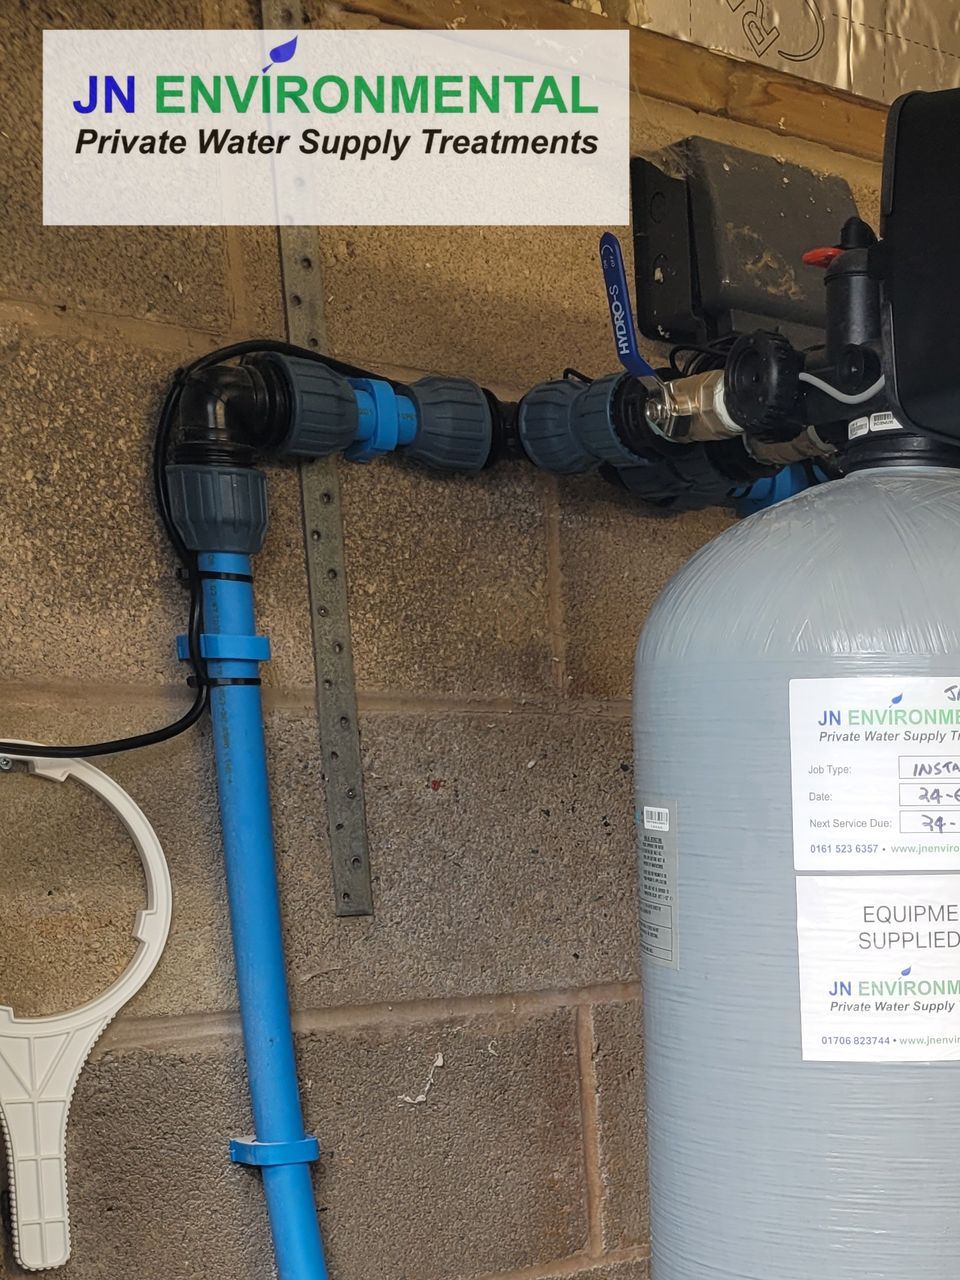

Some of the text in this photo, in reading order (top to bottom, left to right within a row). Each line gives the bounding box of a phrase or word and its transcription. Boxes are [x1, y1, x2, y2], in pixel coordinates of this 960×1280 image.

[609, 284, 630, 355] HYDRO-S
[818, 710, 841, 726] JN
[819, 730, 860, 742] Private
[864, 730, 900, 742] Water
[904, 730, 946, 744] Supply
[808, 764, 852, 776] Job Type:
[809, 792, 832, 802] Date:
[810, 818, 893, 828] Next Service Due:
[810, 844, 832, 854] 0161
[836, 844, 852, 854] 523
[855, 844, 878, 854] 6357
[858, 931, 960, 950] SUPPLIED
[829, 980, 852, 996] JN
[830, 1002, 872, 1012] Private
[875, 1001, 910, 1012] Water
[913, 1000, 954, 1013] Supply
[822, 1036, 851, 1046] 01706
[854, 1036, 890, 1045] 823744
